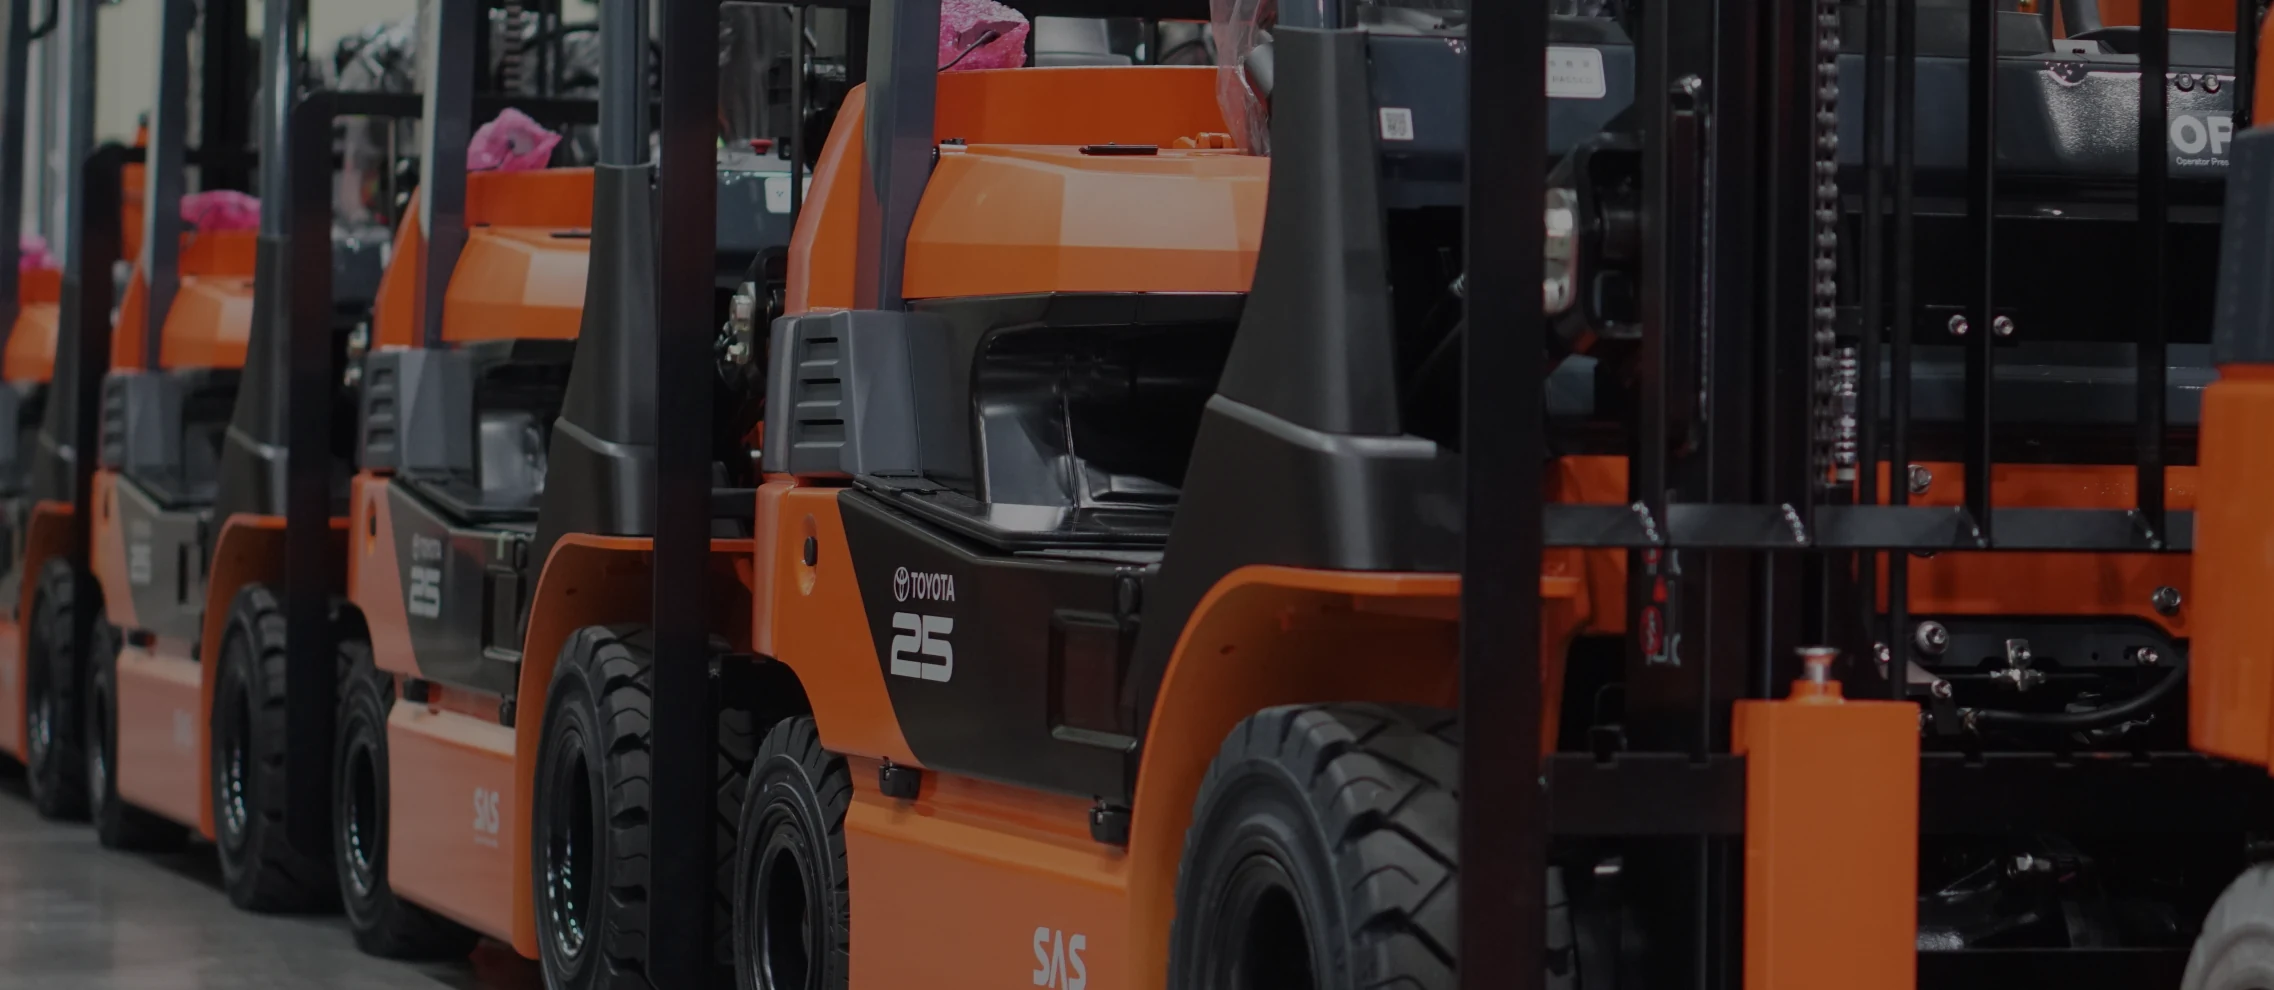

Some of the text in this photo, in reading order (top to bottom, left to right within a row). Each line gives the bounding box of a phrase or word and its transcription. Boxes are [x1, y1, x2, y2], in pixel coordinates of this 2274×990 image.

[2176, 156, 2210, 167] Operator
[408, 566, 442, 620] 25
[911, 571, 955, 602] TOYOTA
[890, 611, 954, 683] 25
[474, 786, 500, 834] SAS
[1033, 926, 1087, 990] SAS
